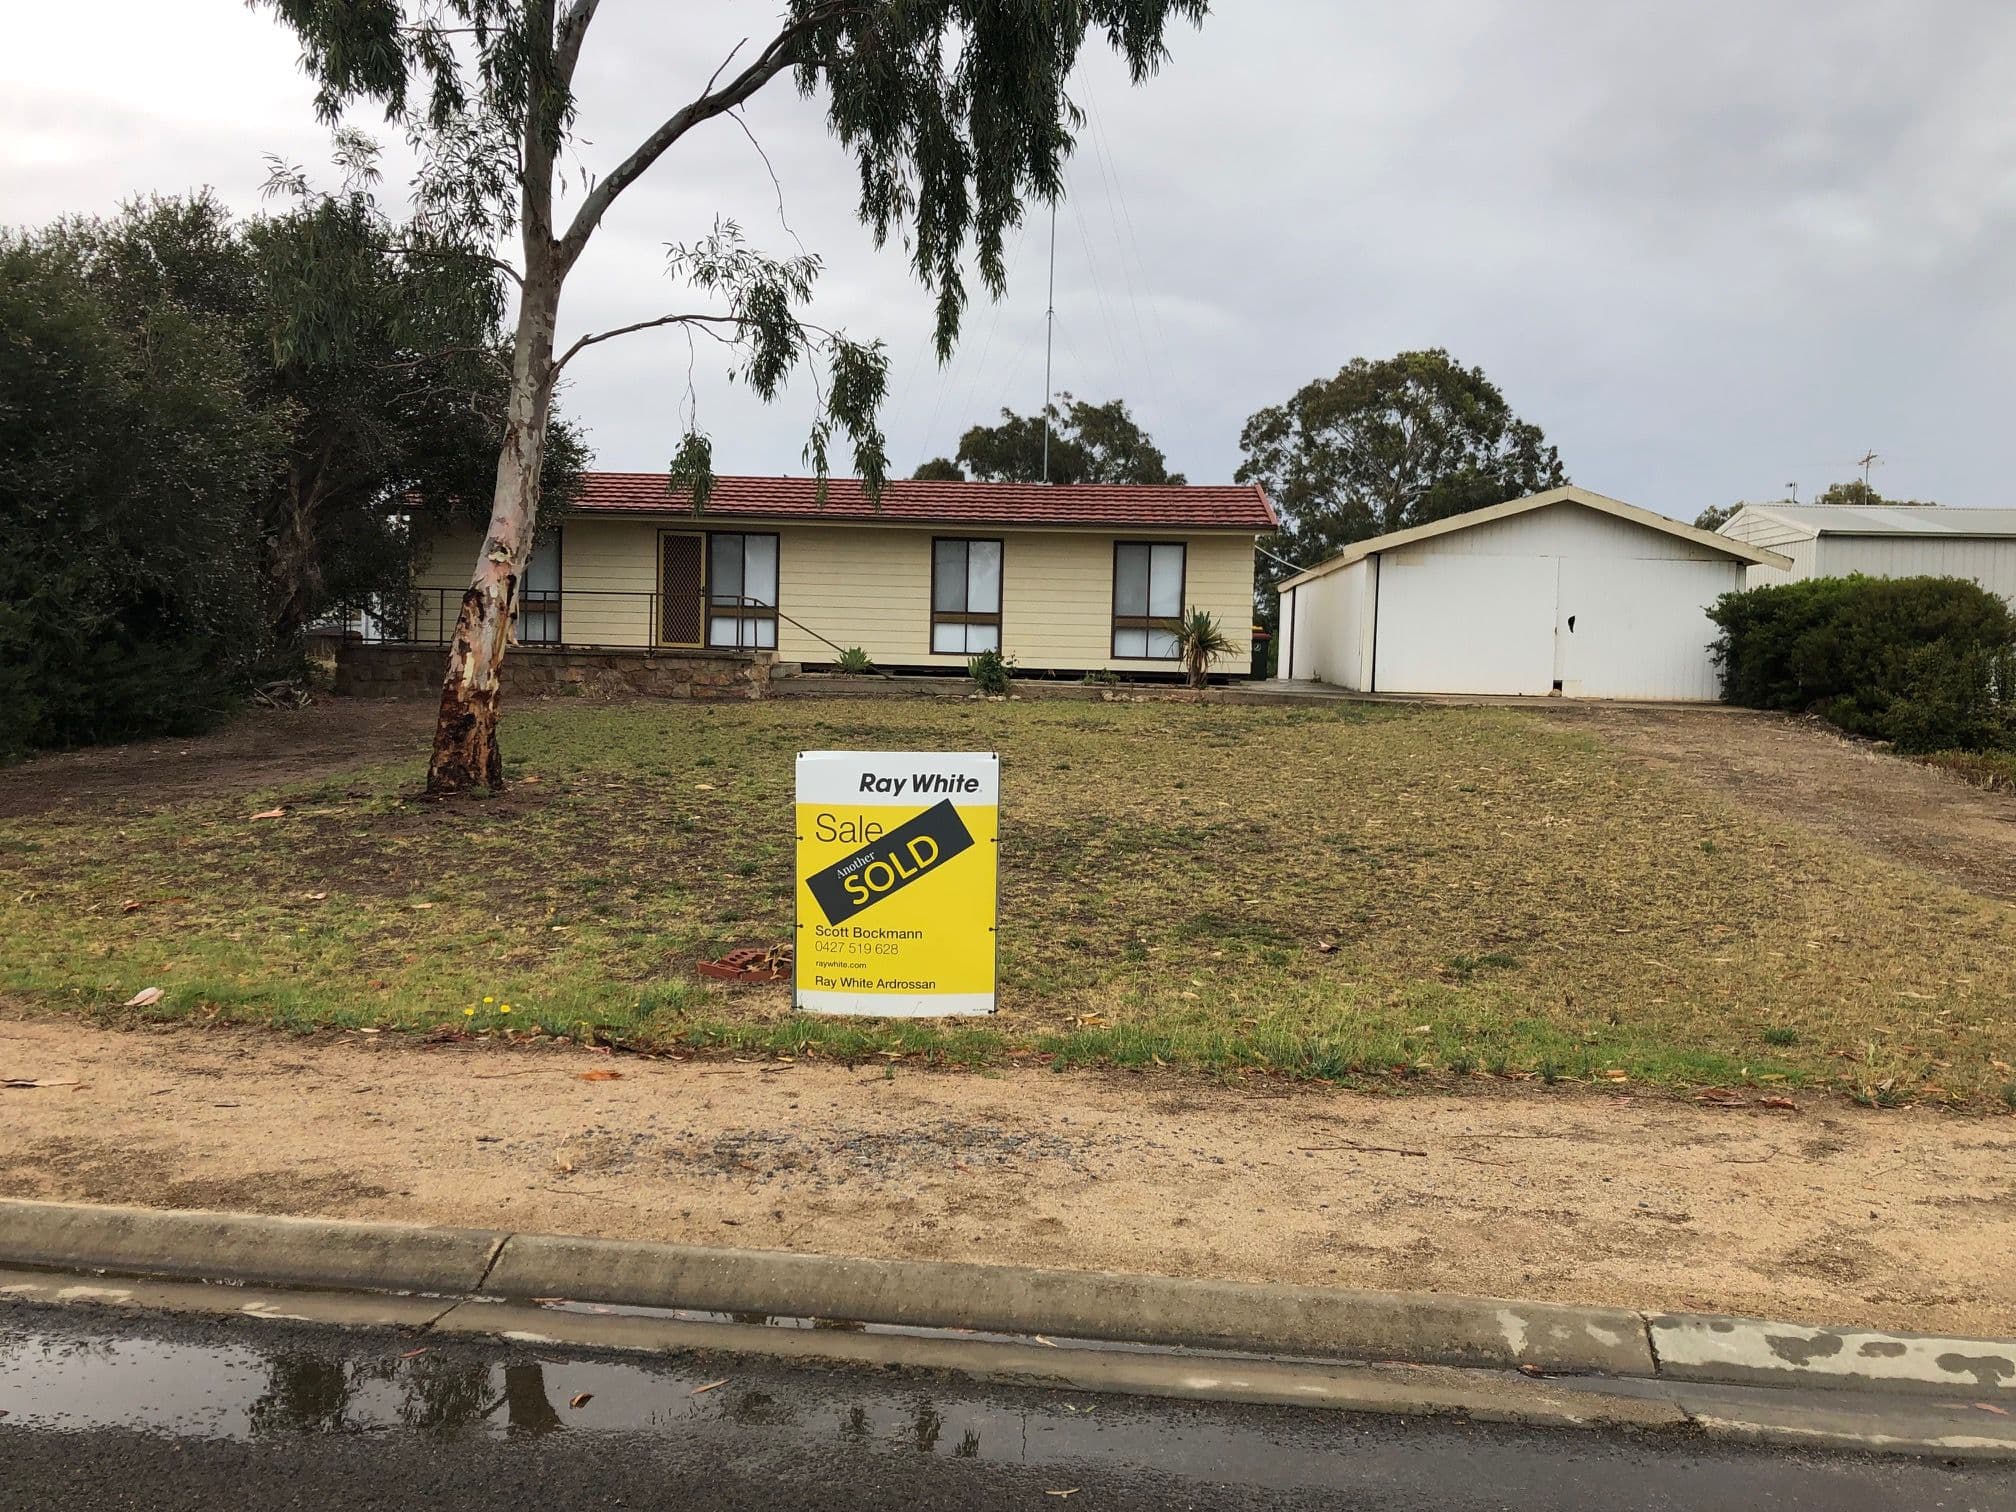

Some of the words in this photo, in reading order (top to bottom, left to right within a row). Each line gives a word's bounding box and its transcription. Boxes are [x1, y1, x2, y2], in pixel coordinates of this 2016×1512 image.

[859, 773, 907, 797] Ray
[912, 773, 979, 793] White
[816, 813, 883, 844] Sale
[837, 850, 875, 880] Another
[843, 835, 939, 905] SOLD
[815, 925, 849, 938] Scott
[853, 927, 923, 940] Bockmann
[815, 940, 845, 953] 0427
[849, 943, 872, 955] 519
[875, 943, 899, 955] 628
[815, 960, 867, 970] raywhite.com
[815, 975, 837, 990] Ray
[840, 977, 873, 989] White
[876, 978, 936, 990] Ardrossan
